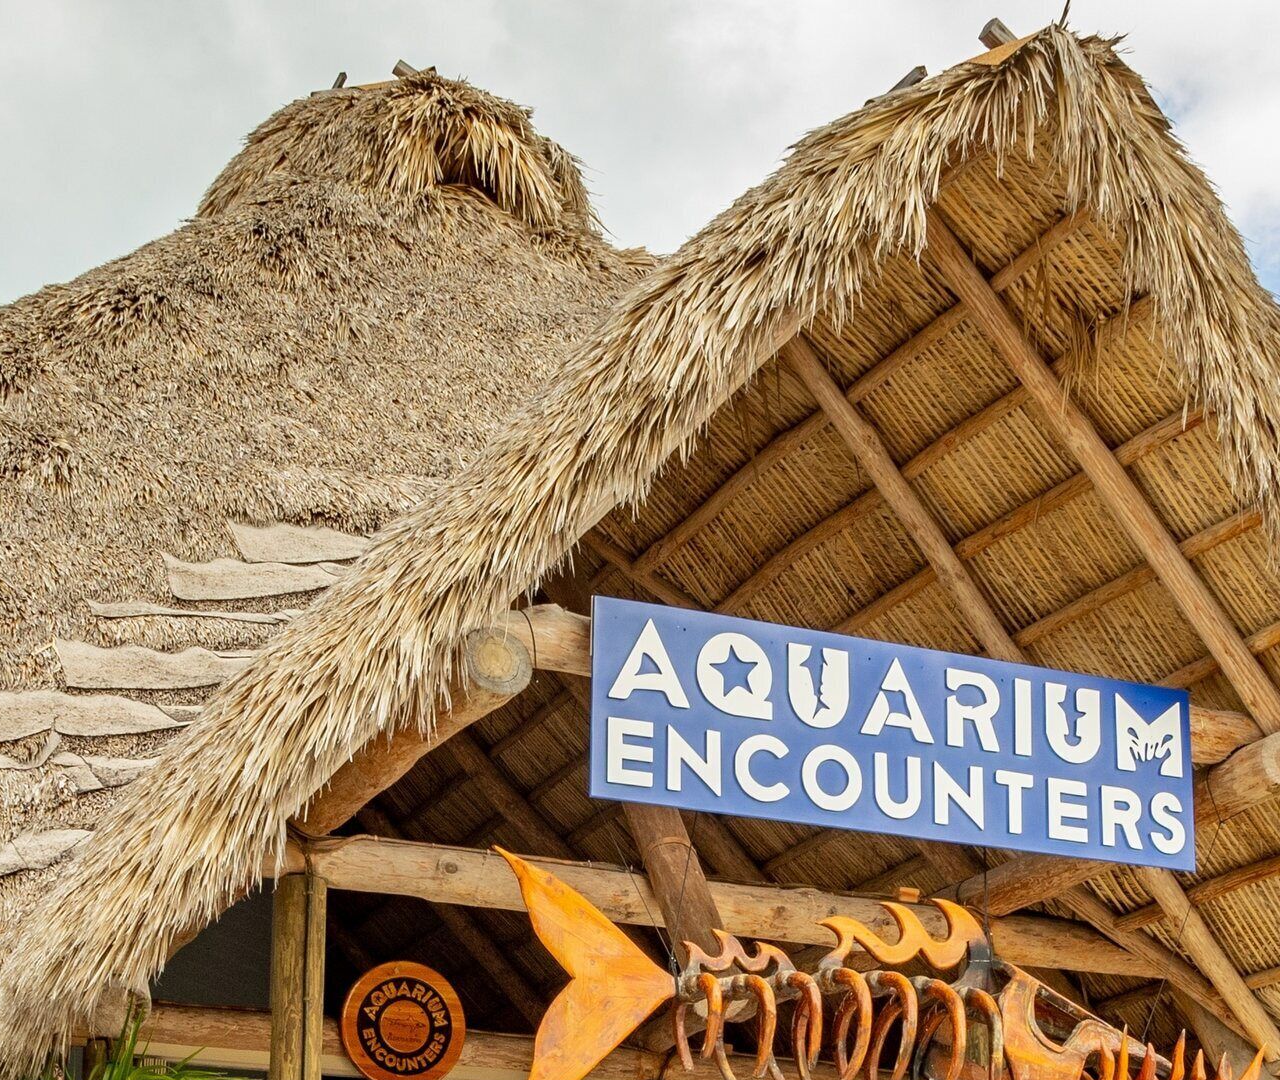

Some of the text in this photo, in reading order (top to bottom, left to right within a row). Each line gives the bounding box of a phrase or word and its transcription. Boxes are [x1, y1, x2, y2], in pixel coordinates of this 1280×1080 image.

[608, 618, 1184, 778] AQUARIUM
[606, 716, 1186, 855] ENCOUNTERS
[363, 981, 448, 1027] AQUARIUM
[363, 1028, 446, 1071] ENCOUNTERS
